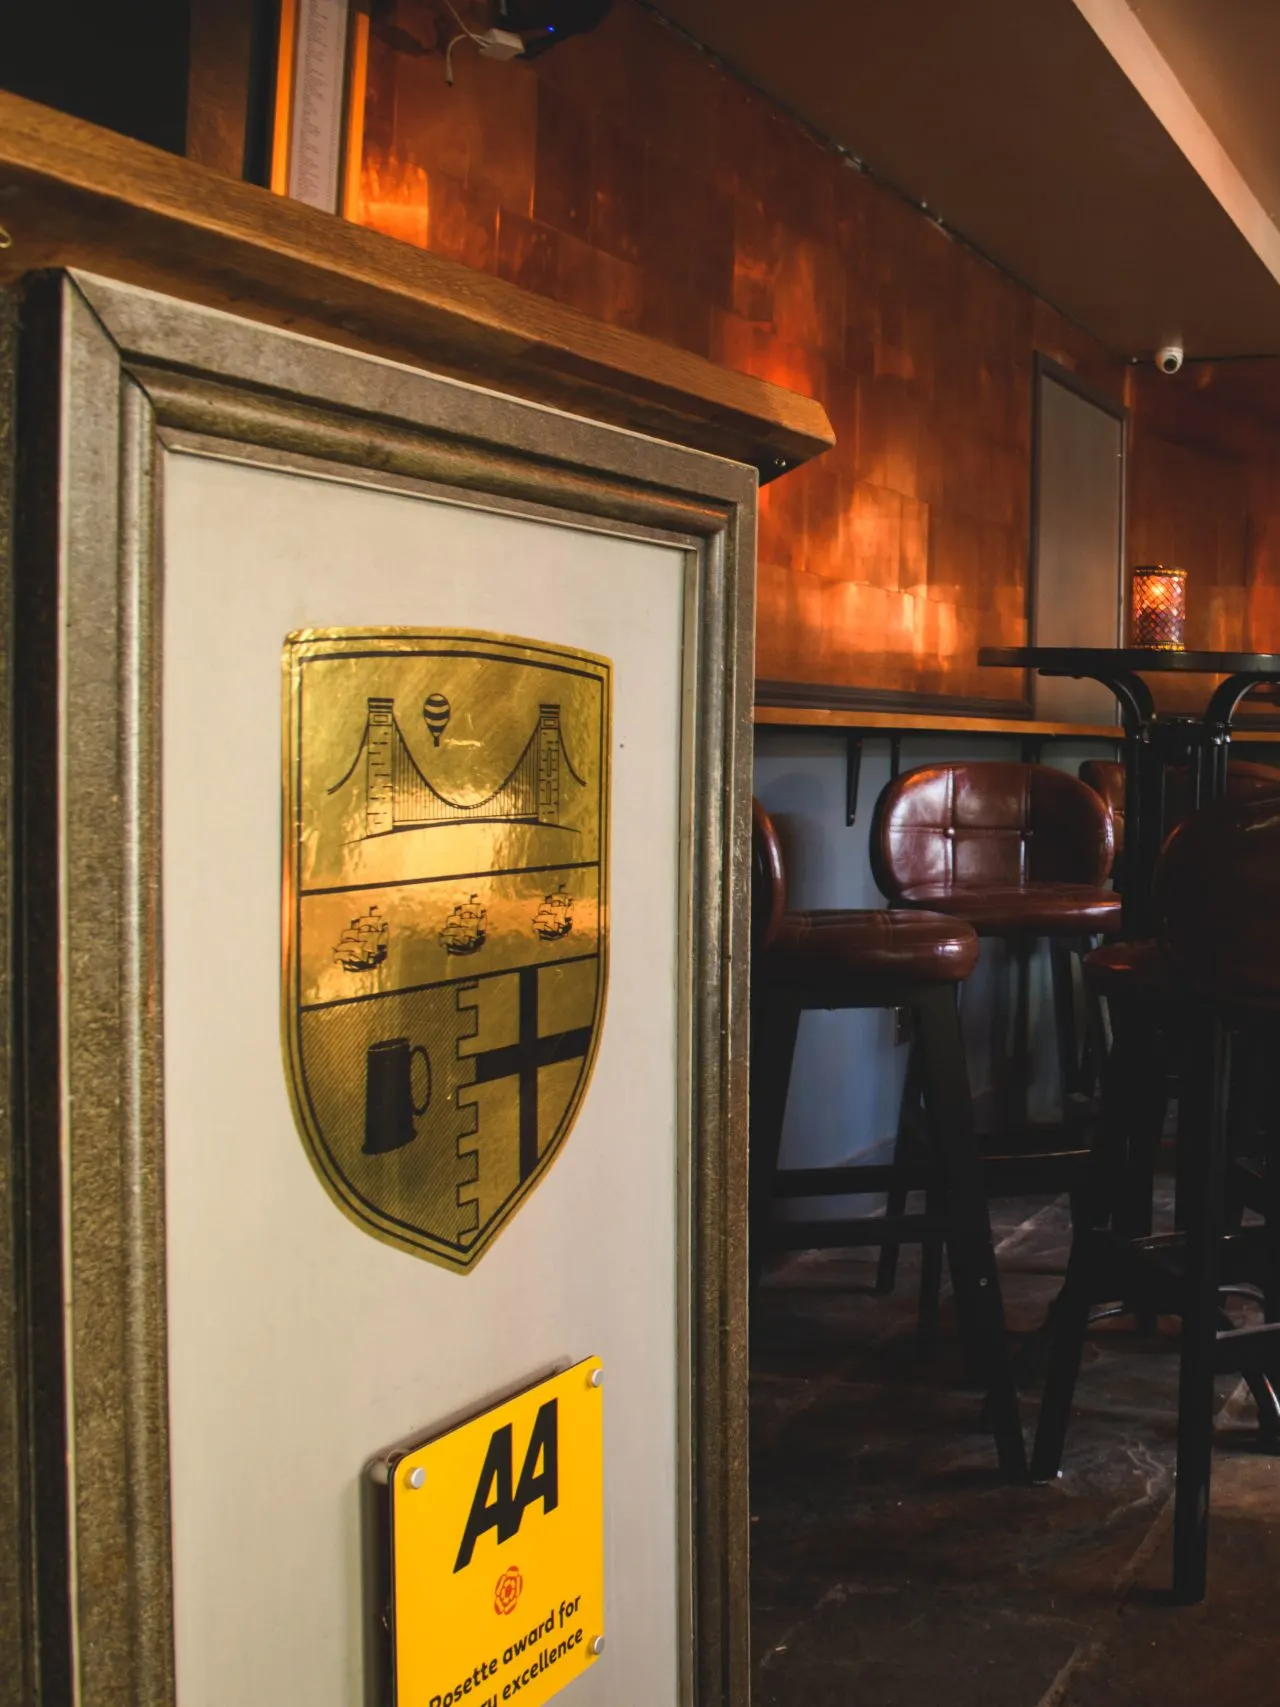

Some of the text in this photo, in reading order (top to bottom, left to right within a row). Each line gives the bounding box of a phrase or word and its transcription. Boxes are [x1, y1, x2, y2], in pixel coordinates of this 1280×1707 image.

[453, 1397, 558, 1575] AA
[502, 1609, 556, 1665] award
[559, 1596, 582, 1629] for
[502, 1628, 583, 1700] excellence
